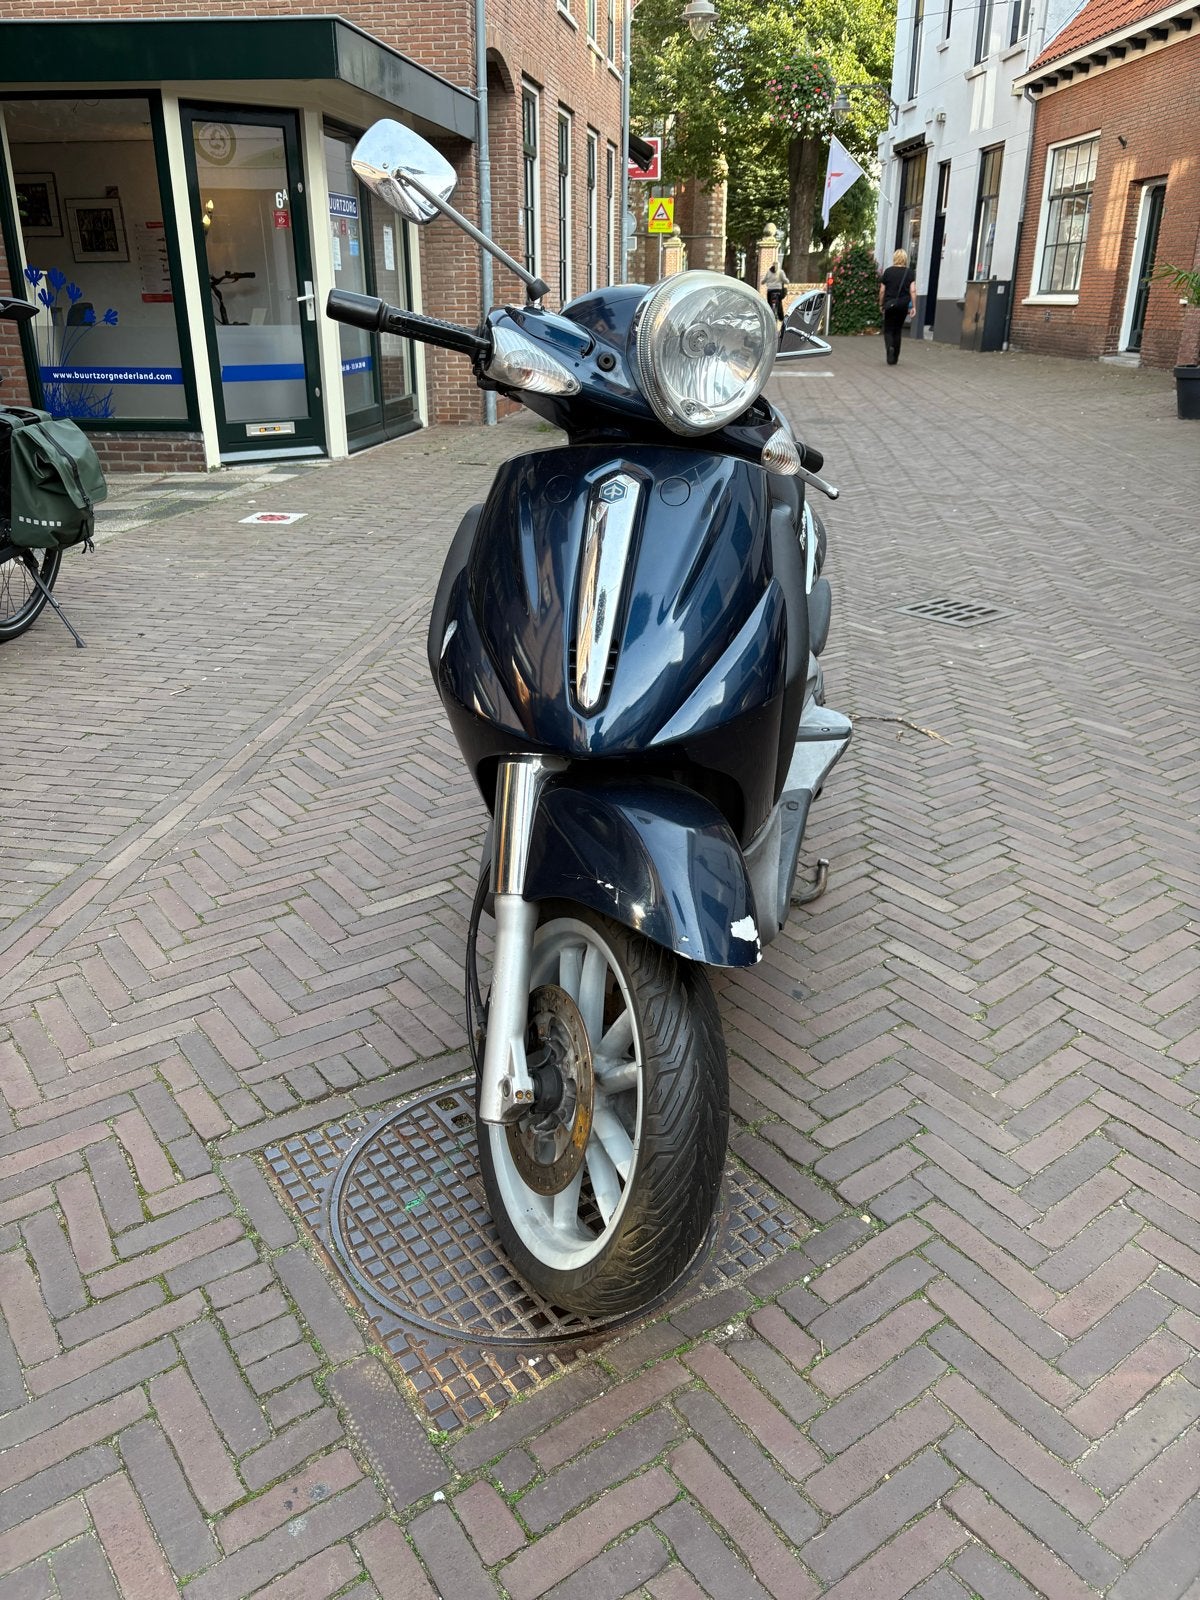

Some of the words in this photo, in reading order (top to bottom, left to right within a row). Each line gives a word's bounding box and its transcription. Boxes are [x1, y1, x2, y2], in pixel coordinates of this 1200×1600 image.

[275, 189, 289, 209] 6A
[329, 197, 357, 214] UURTZORG
[52, 371, 173, 381] www.buurtzorgnederland.com
